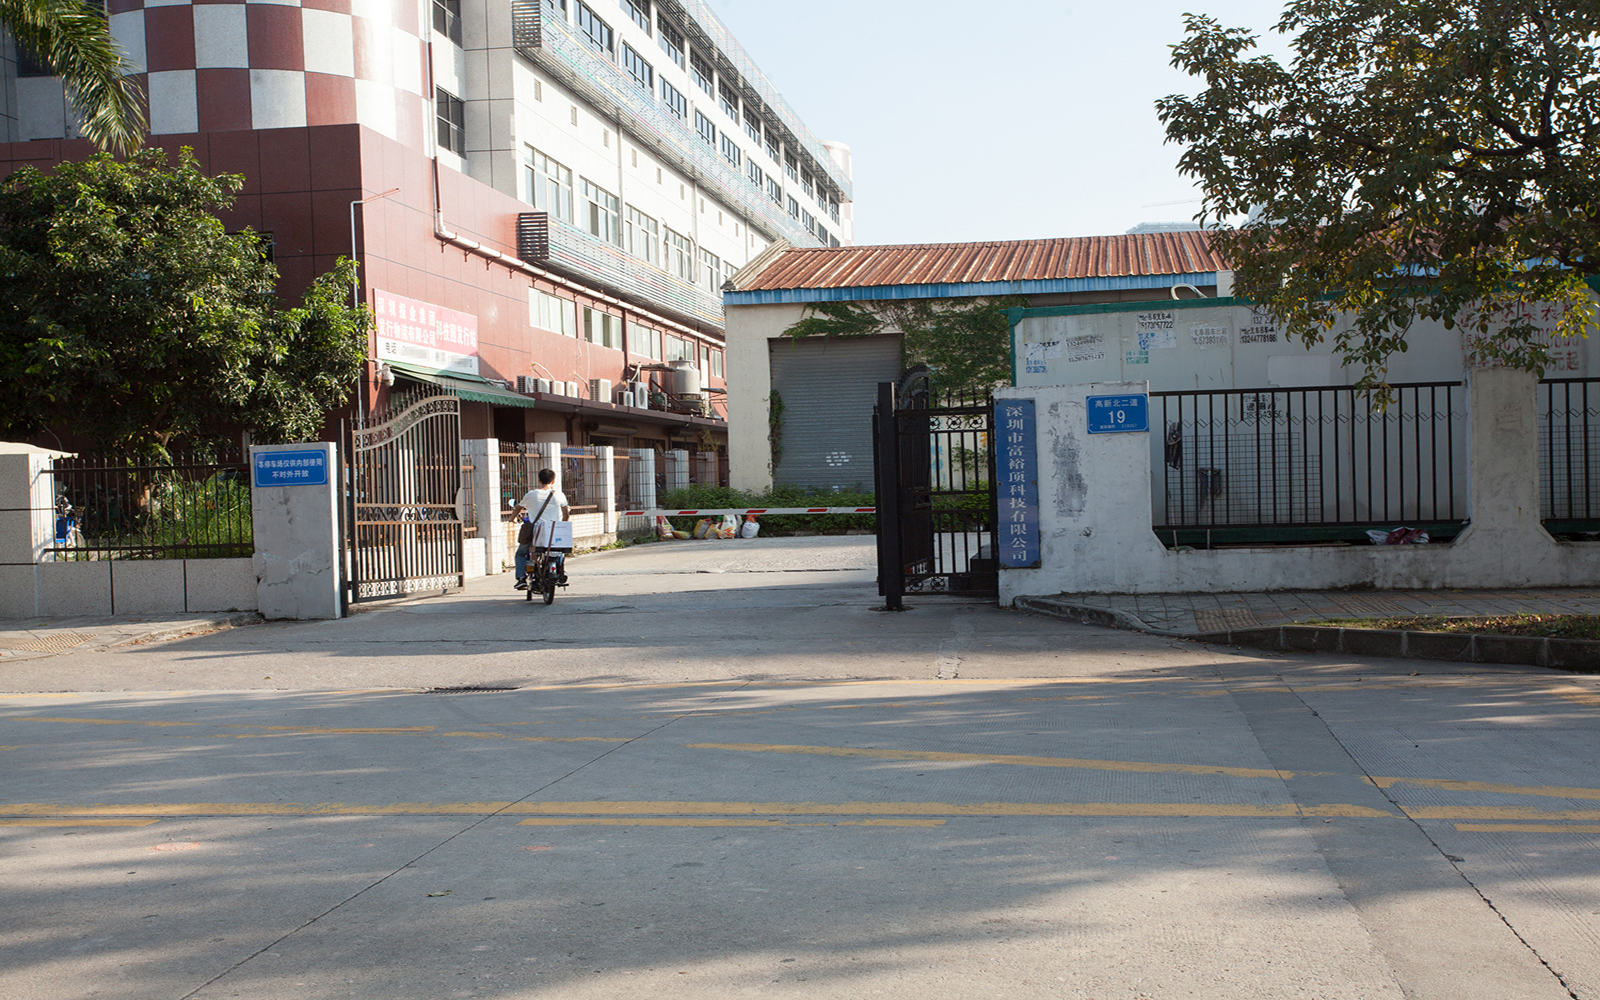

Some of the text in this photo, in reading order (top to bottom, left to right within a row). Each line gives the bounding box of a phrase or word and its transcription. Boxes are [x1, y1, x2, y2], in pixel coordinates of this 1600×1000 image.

[1095, 398, 1138, 408] 高新北二道
[1108, 410, 1126, 424] 19
[258, 458, 323, 469] 本停车场仅供内部使用
[272, 469, 309, 478] 不对外开放
[1005, 405, 1028, 562] 深圳市富裕顶科技有限公司
